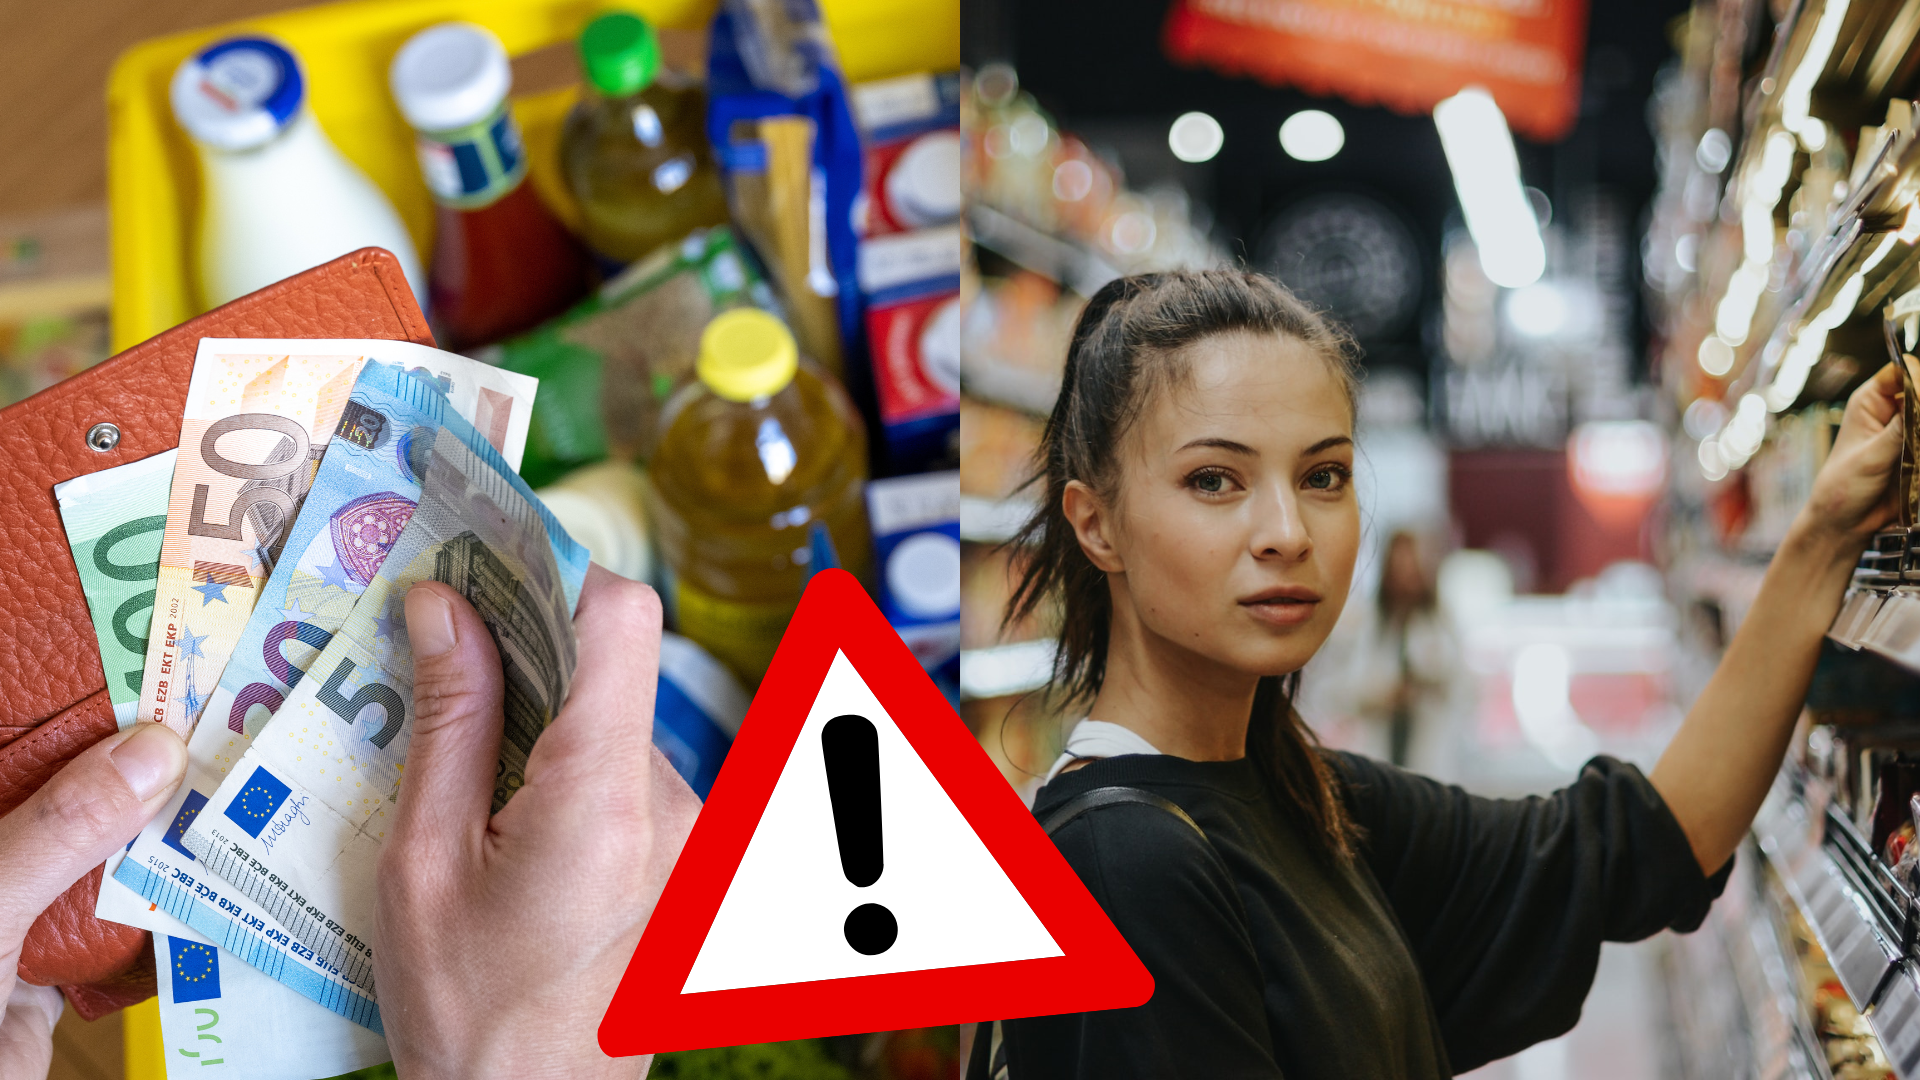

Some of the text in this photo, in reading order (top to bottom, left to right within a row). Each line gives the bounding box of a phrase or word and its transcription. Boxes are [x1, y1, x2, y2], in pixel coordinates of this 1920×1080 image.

[188, 413, 310, 548] 50
[153, 597, 180, 723] CB EZB EKT EKP 2002
[315, 656, 405, 750] 5
[211, 828, 229, 845] 2013
[229, 842, 250, 862] EBC
[147, 855, 170, 873] 2015
[171, 867, 196, 888] EBC
[268, 873, 289, 892] EKB
[218, 897, 243, 918] EKB
[287, 888, 307, 908] EKT
[241, 912, 266, 932] EKT
[305, 906, 327, 924] EKP
[265, 928, 291, 947] EKP
[325, 919, 346, 938] EZB
[290, 941, 315, 961] EZB
